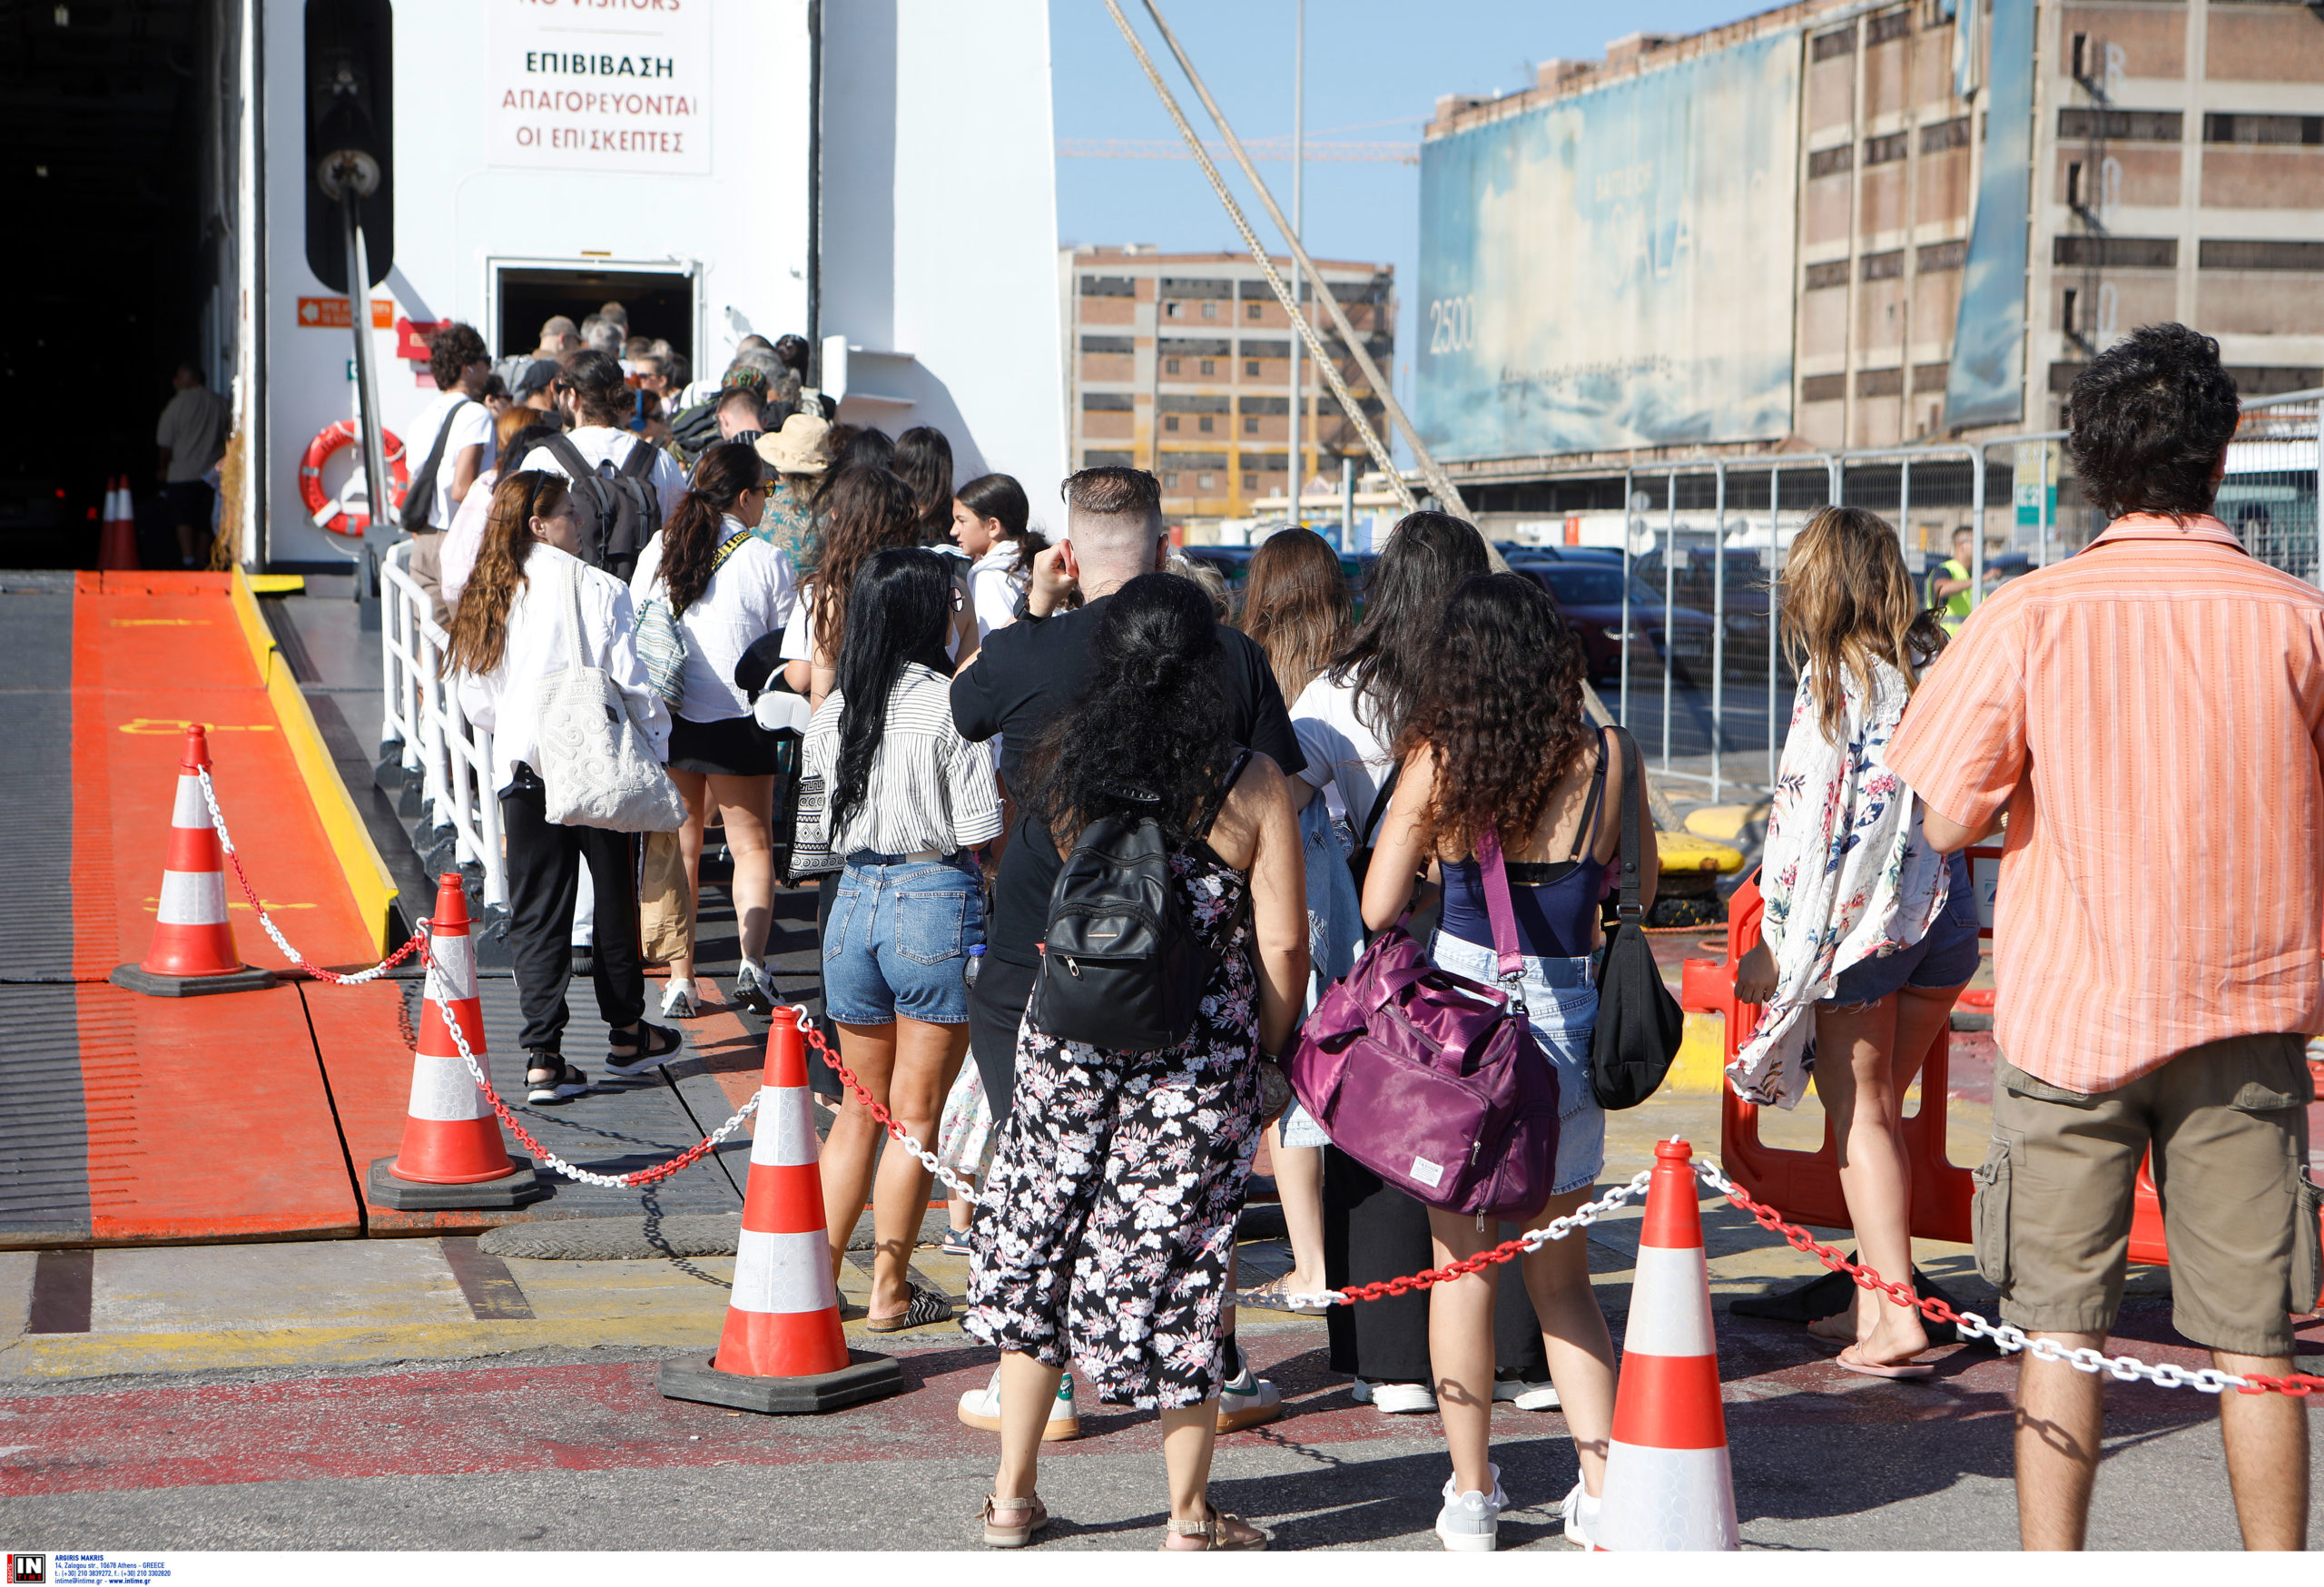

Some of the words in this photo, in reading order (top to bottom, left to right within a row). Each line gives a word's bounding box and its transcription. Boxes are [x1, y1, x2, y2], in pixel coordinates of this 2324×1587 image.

[527, 52, 675, 78] ΕΠΙΒΙΒΑΣΗ
[502, 89, 698, 116] ΑΠΑΓΟΡΕΥΟΝΤΑΙ
[517, 126, 541, 147] ΟΙ
[551, 128, 684, 153] ΕΠΙΣΚΕΠΤΕΣ
[1429, 294, 1475, 355] 2500
